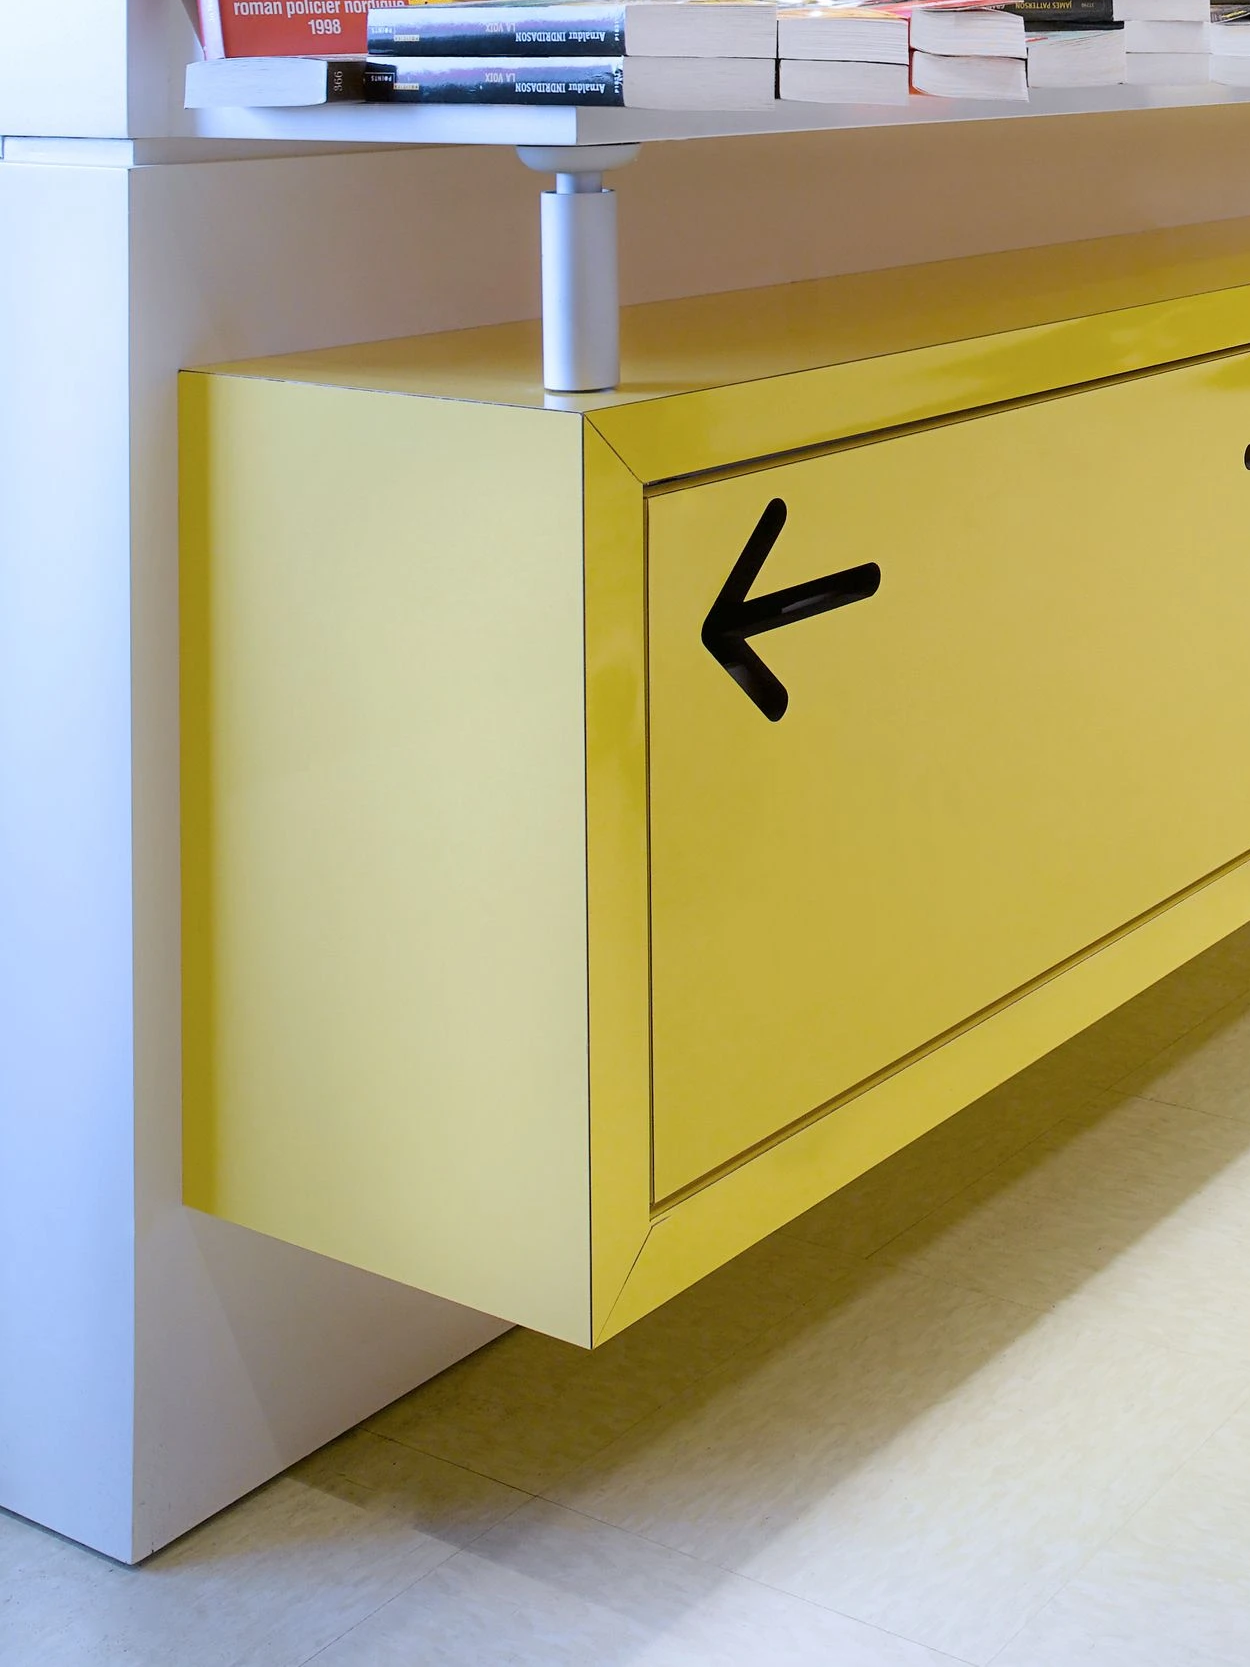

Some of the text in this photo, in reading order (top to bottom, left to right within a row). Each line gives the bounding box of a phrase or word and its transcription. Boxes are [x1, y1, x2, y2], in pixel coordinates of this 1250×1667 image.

[233, 1, 283, 16] roman
[1015, 0, 1073, 11] JAMES PATTERSON
[308, 20, 341, 35] 1998
[485, 22, 516, 32] LA VOIX
[515, 32, 605, 42] Arnaldur INDRIDASON
[333, 71, 343, 93] 366
[485, 72, 516, 82] LA VOIX
[515, 83, 605, 94] Arnaldur INDRIDASON
